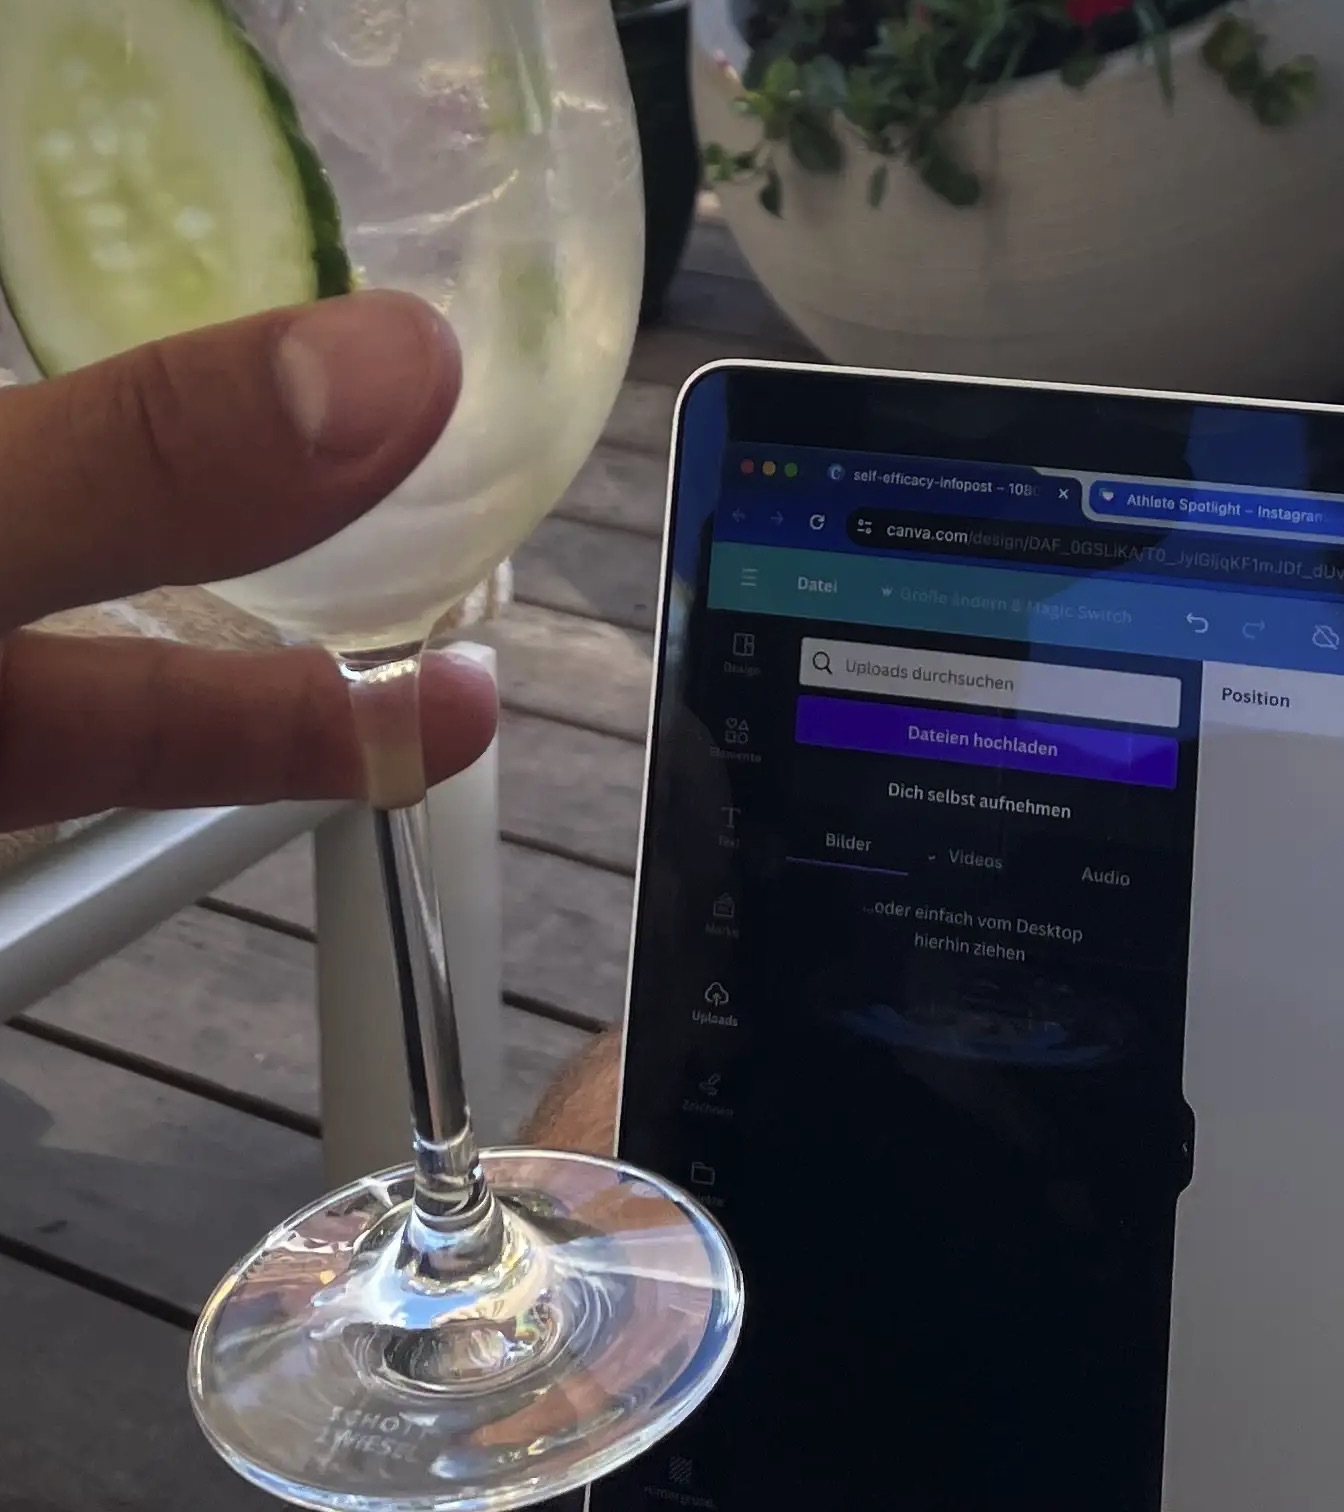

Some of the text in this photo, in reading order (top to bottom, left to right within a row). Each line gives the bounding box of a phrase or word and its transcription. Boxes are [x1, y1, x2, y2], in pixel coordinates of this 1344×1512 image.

[853, 468, 993, 494] self-efficacy-infopost
[1127, 493, 1175, 511] Athlete
[1179, 497, 1241, 518] Spotlight
[797, 575, 838, 595] Datei
[845, 656, 1015, 692] Uploads durchsuchen
[1221, 686, 1291, 711] Position
[907, 724, 1058, 758] Dateien hochladen
[887, 782, 1072, 820] Dich selbst aufnehmen
[825, 831, 873, 854] Bilder
[948, 847, 1004, 870] Videos
[1081, 865, 1132, 887] Audio
[914, 904, 974, 927] einfach
[977, 915, 1012, 932] vom
[1016, 918, 1084, 944] Desktop
[913, 931, 1026, 962] hierhin ziehen
[691, 1007, 739, 1028] Uploads
